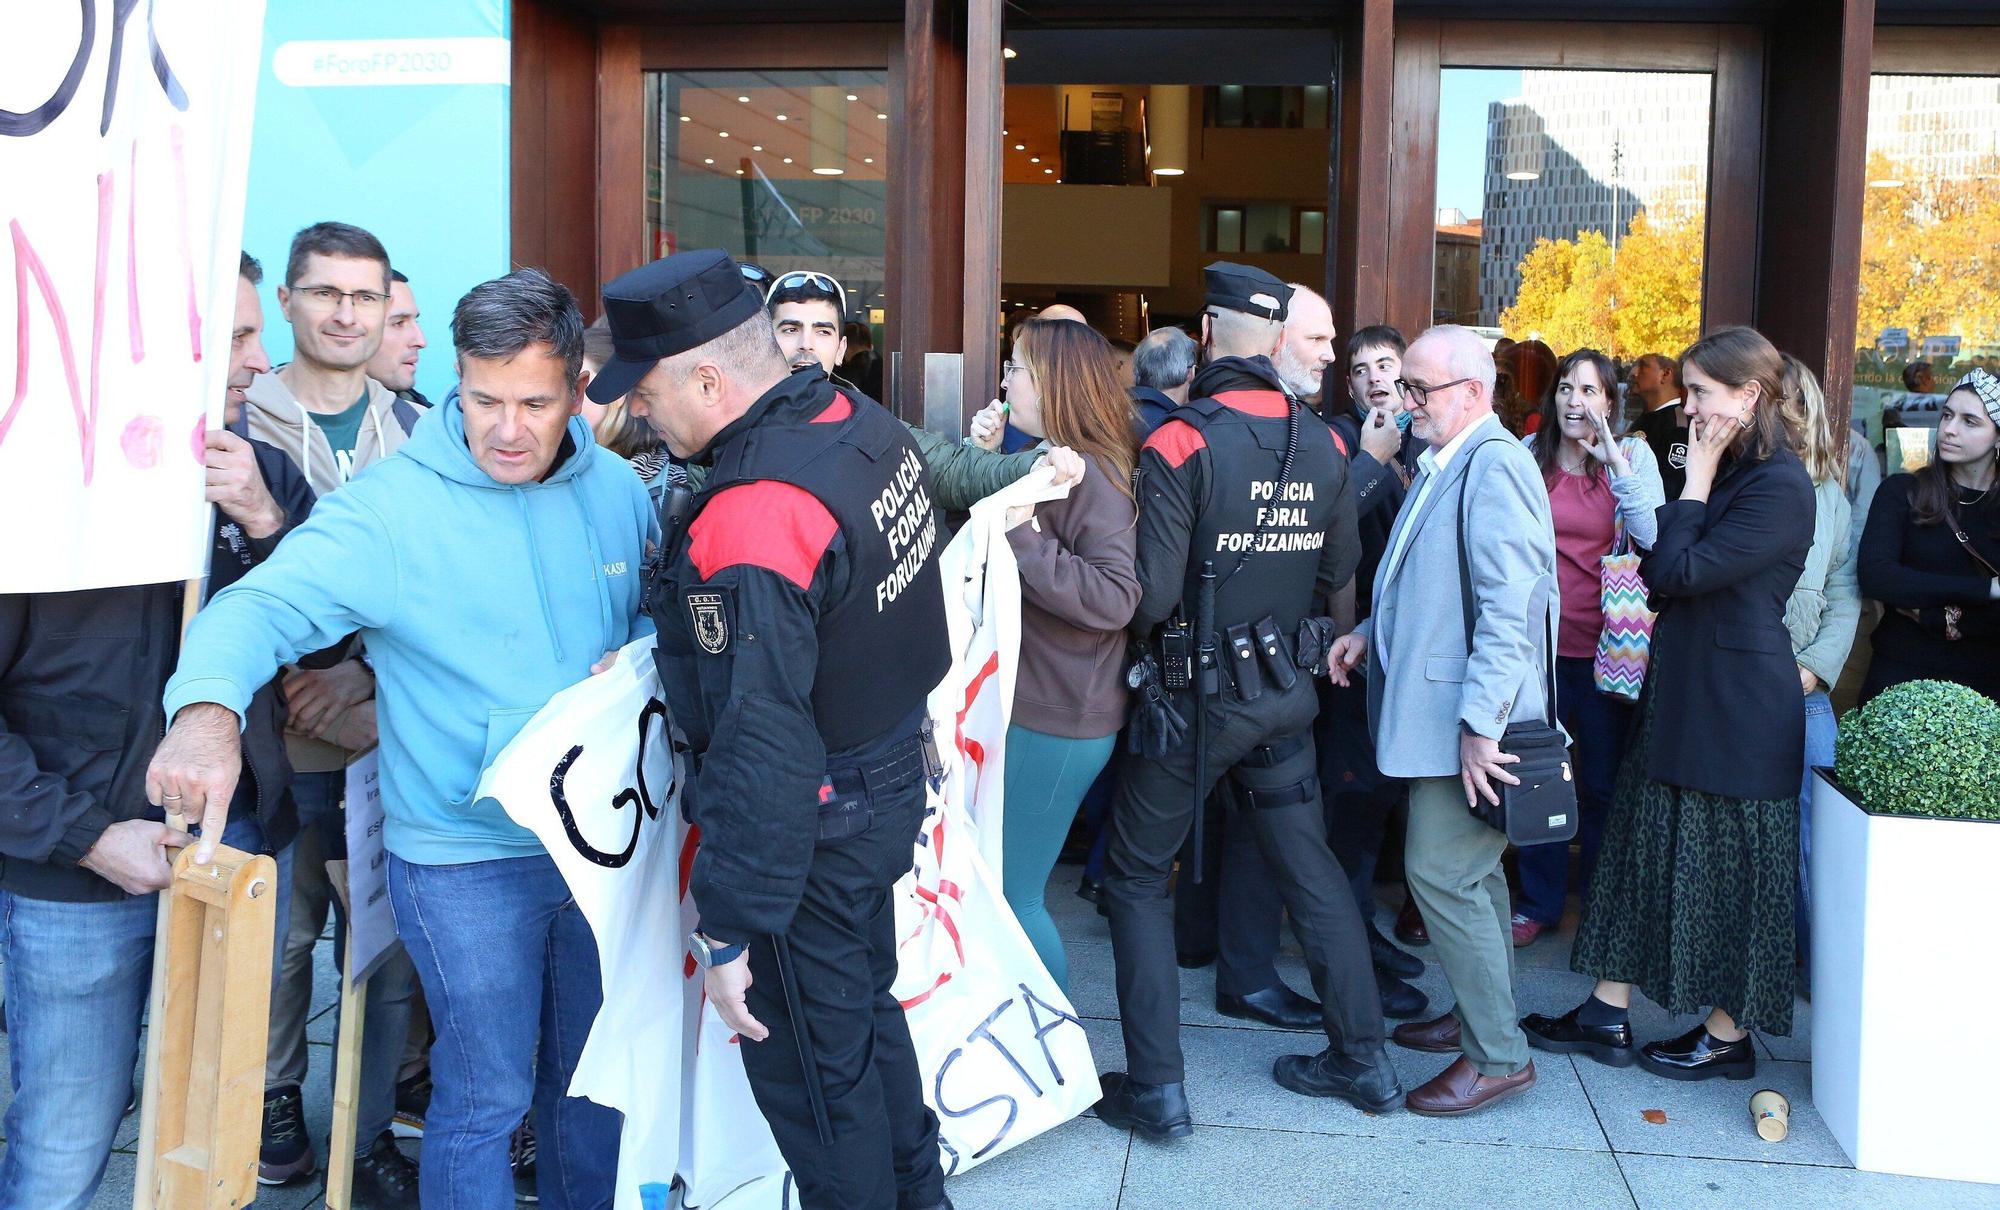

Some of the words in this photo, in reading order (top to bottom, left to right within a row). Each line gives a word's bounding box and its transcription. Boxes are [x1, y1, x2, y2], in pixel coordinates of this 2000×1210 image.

[313, 52, 451, 74] #ForoFP2030
[800, 207, 823, 224] FP
[829, 207, 875, 224] 2030
[870, 446, 922, 533] POLICÍA
[887, 484, 931, 561] FORAL
[1256, 507, 1309, 527] FORAL
[932, 983, 1085, 1177] STA
